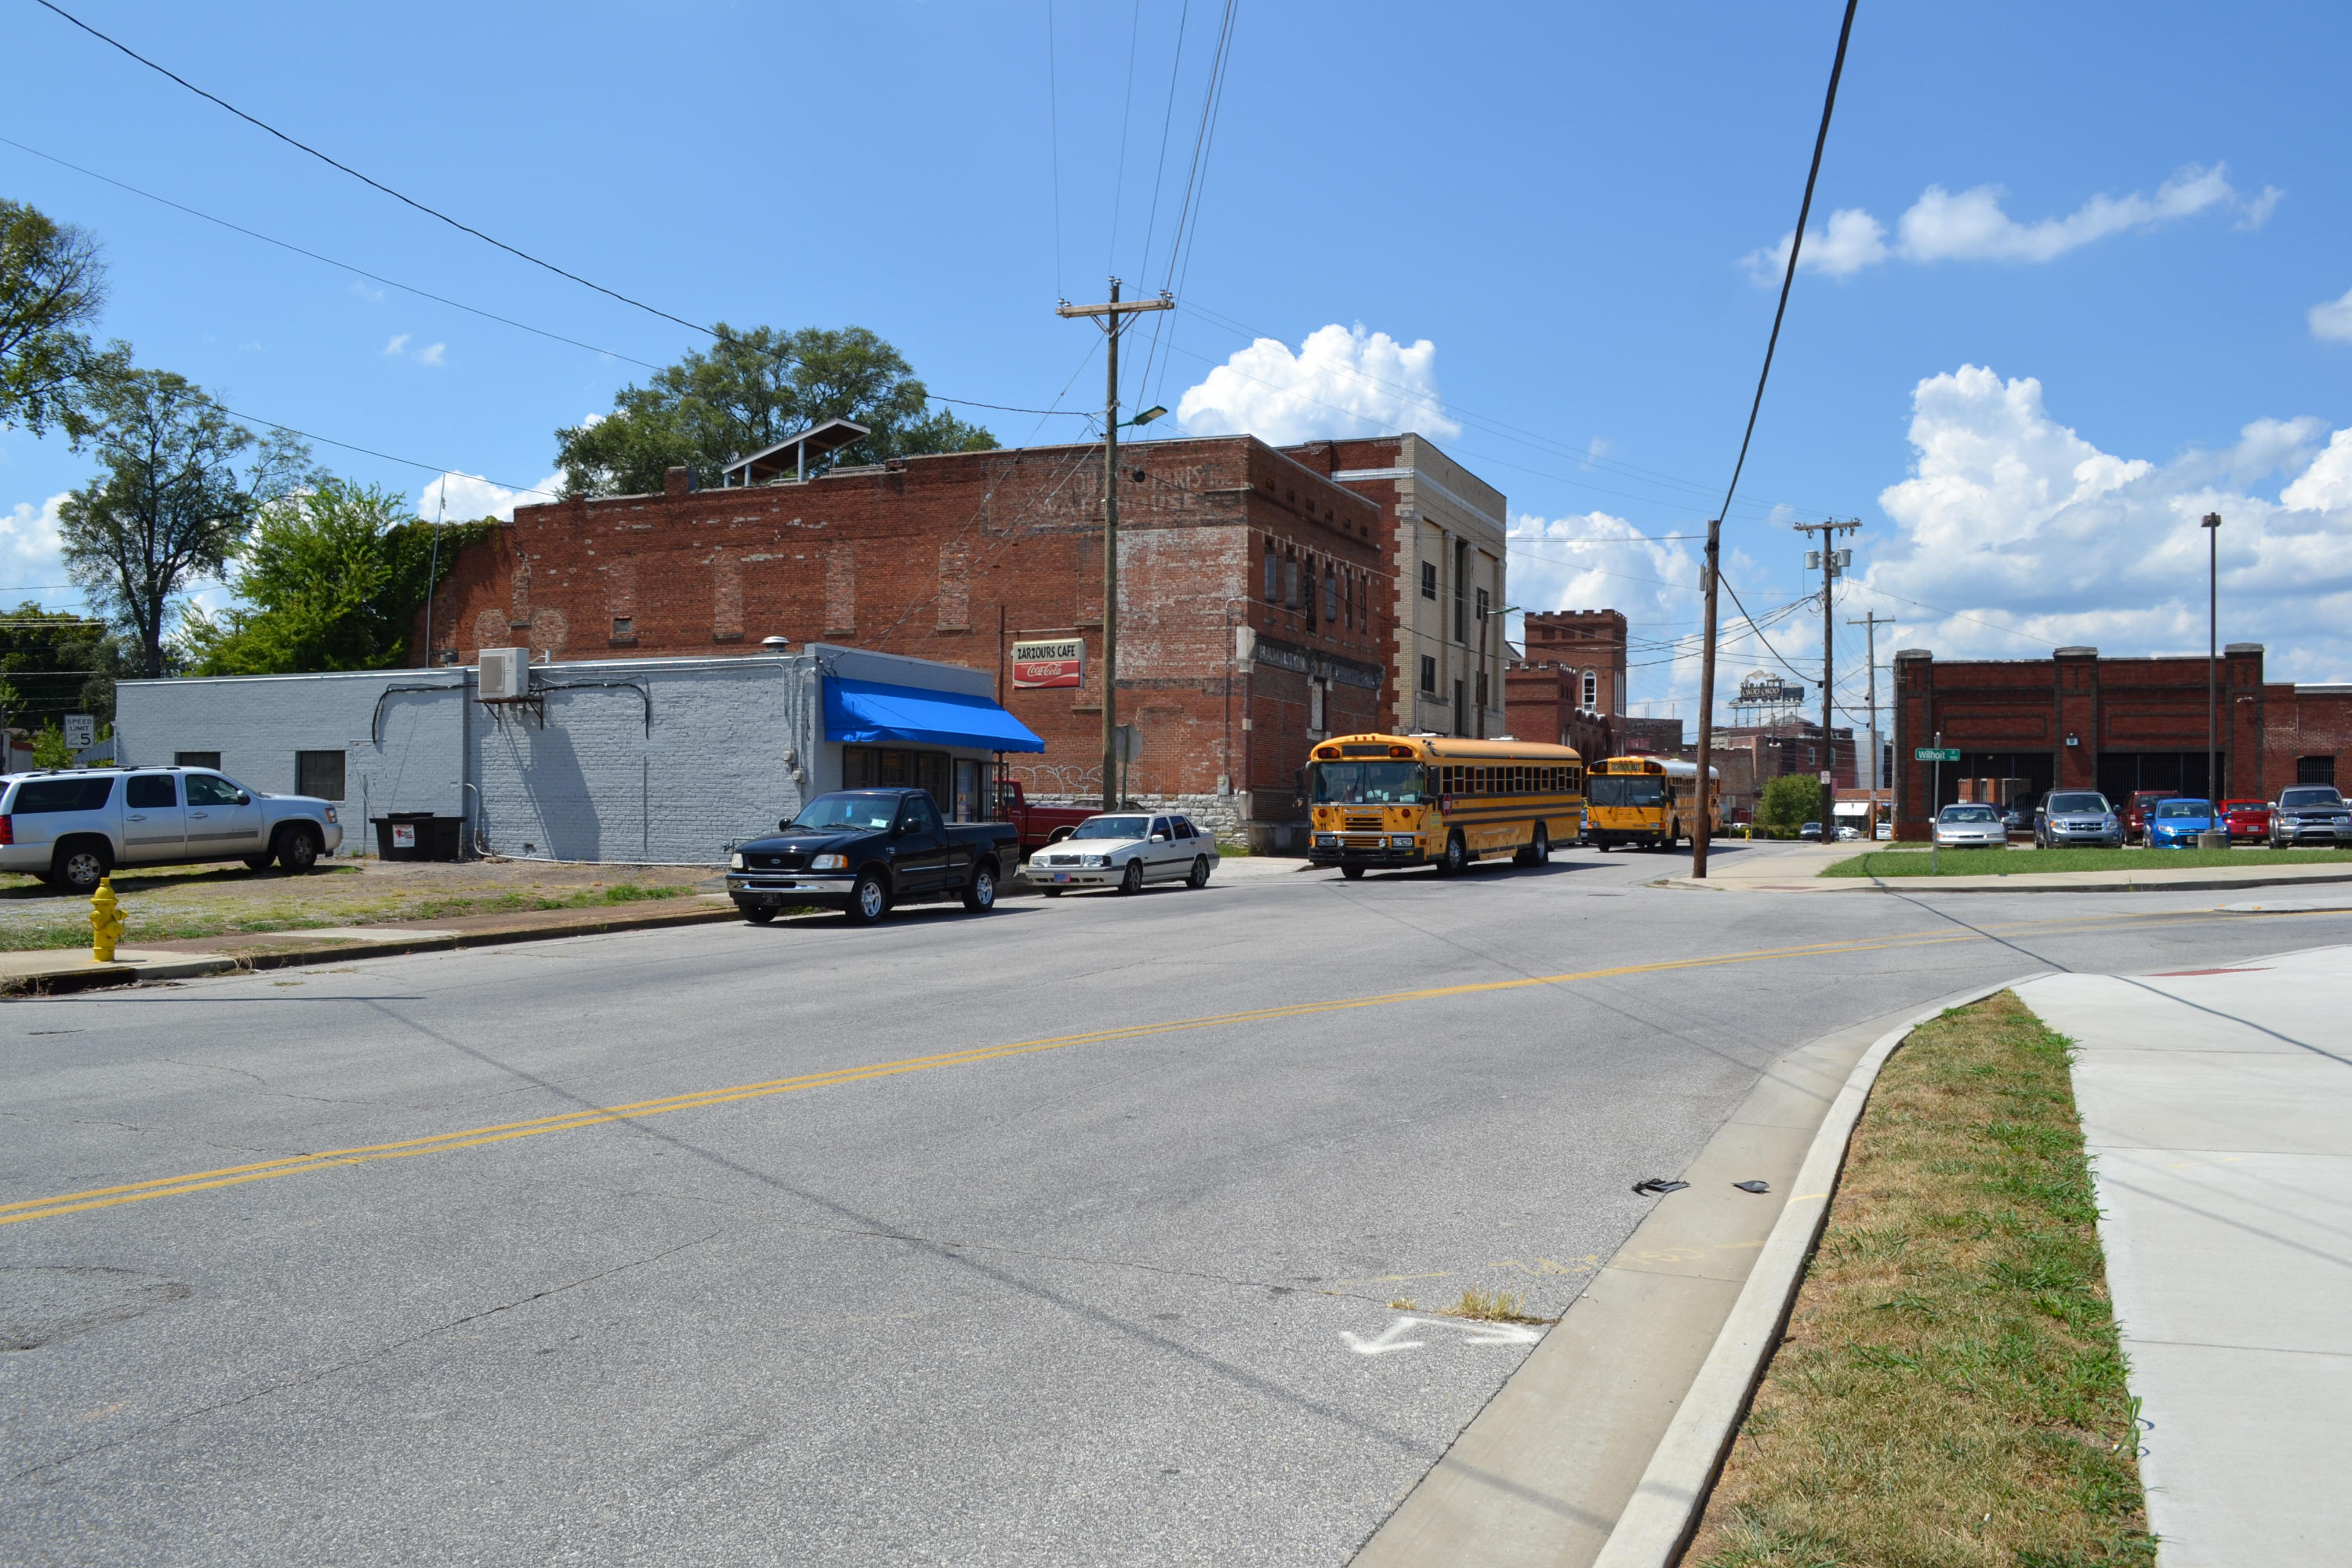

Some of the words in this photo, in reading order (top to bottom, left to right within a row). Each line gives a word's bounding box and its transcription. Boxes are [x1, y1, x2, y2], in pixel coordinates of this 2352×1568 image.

[1017, 646, 1055, 659] ZARZOURS
[1058, 644, 1076, 657] CAFE
[1027, 663, 1062, 677] Coca-Cola
[68, 732, 91, 746] 25
[1918, 750, 1946, 760] Wilhoit
[1319, 822, 1327, 831] 11
